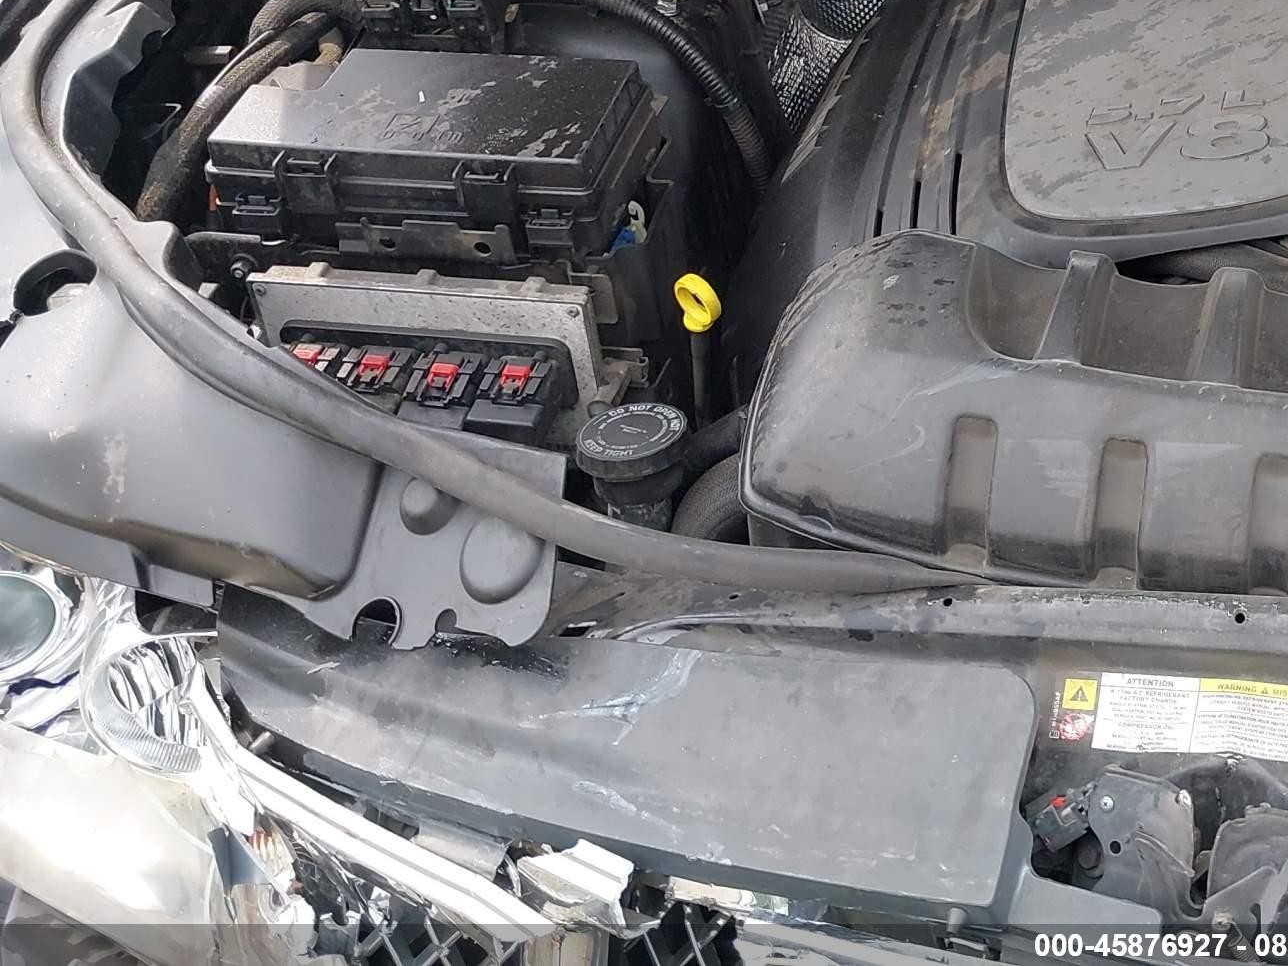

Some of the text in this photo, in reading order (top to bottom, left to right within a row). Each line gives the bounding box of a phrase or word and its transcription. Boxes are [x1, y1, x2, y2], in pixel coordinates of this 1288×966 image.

[1085, 89, 1266, 127] 5.7L
[1085, 113, 1271, 171] V8
[608, 408, 625, 417] DO
[653, 405, 678, 419] OPEN
[583, 439, 634, 457] KEEP TIGHT
[1126, 677, 1175, 688] ATTENTION
[1217, 682, 1258, 694] WARNING
